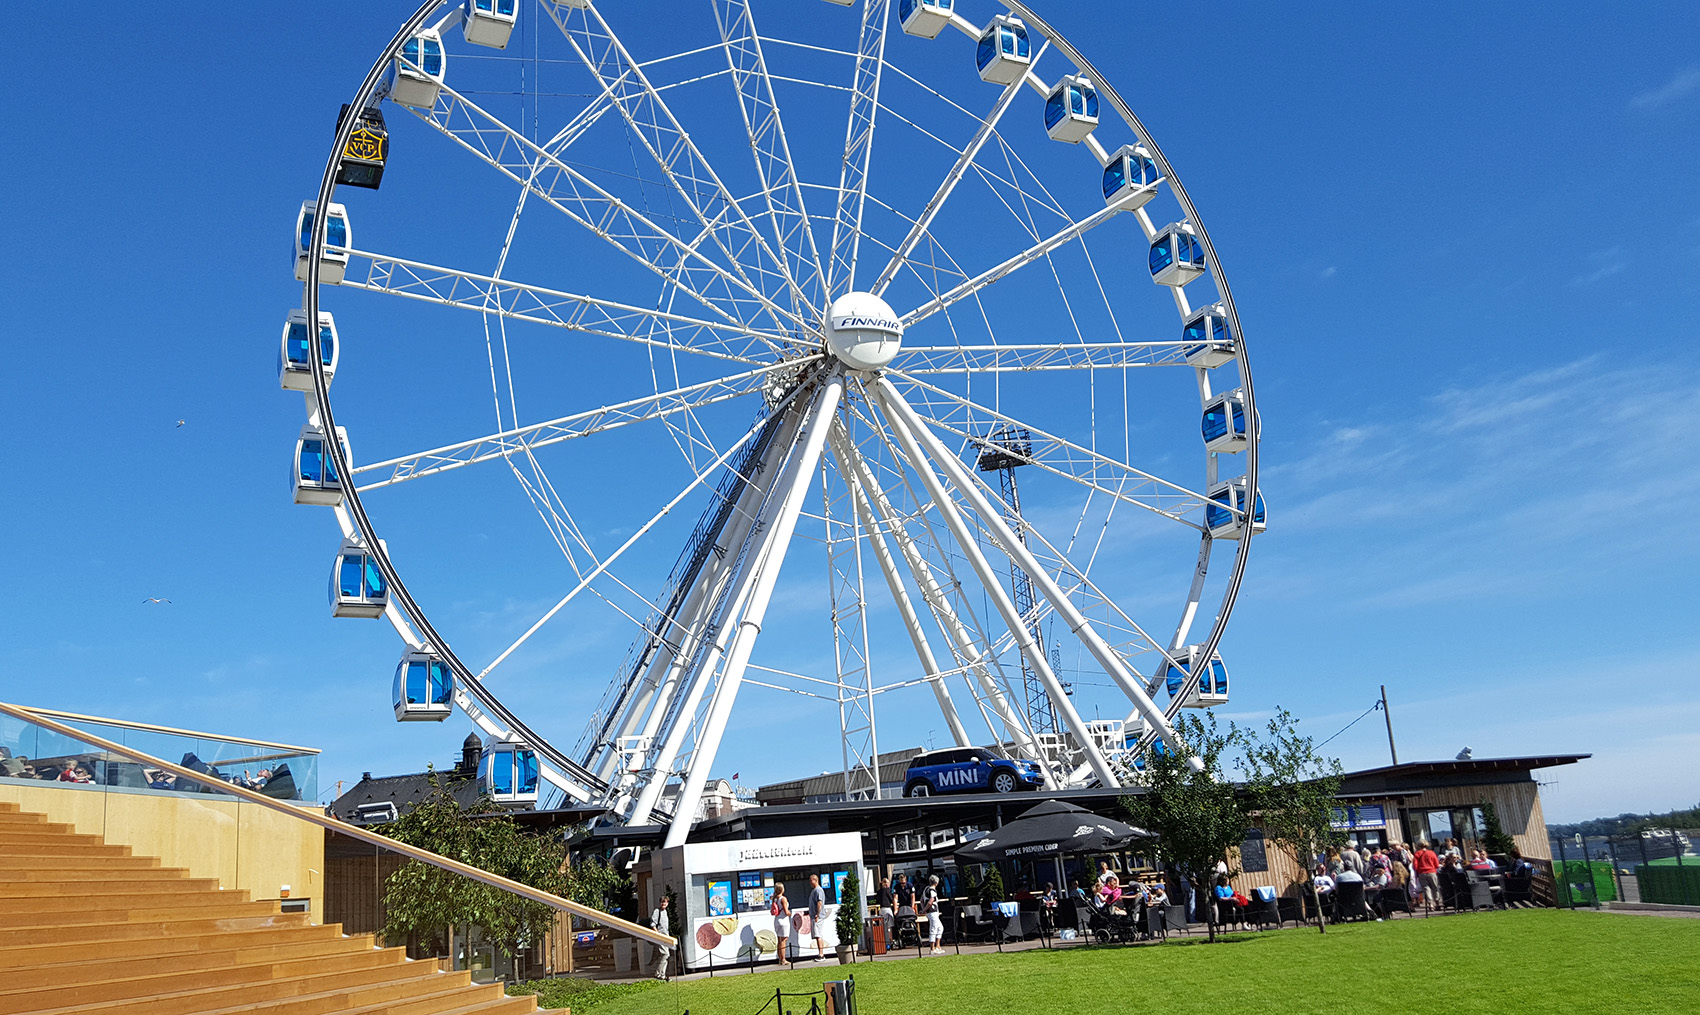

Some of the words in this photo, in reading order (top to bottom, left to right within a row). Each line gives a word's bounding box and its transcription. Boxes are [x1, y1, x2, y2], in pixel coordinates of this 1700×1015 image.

[352, 142, 375, 153] VCP
[841, 317, 899, 330] FINNAIR
[938, 768, 979, 787] MINI
[1005, 847, 1021, 857] SIMPLE
[1022, 844, 1045, 855] PREMIUM
[1045, 843, 1059, 852] CIDER
